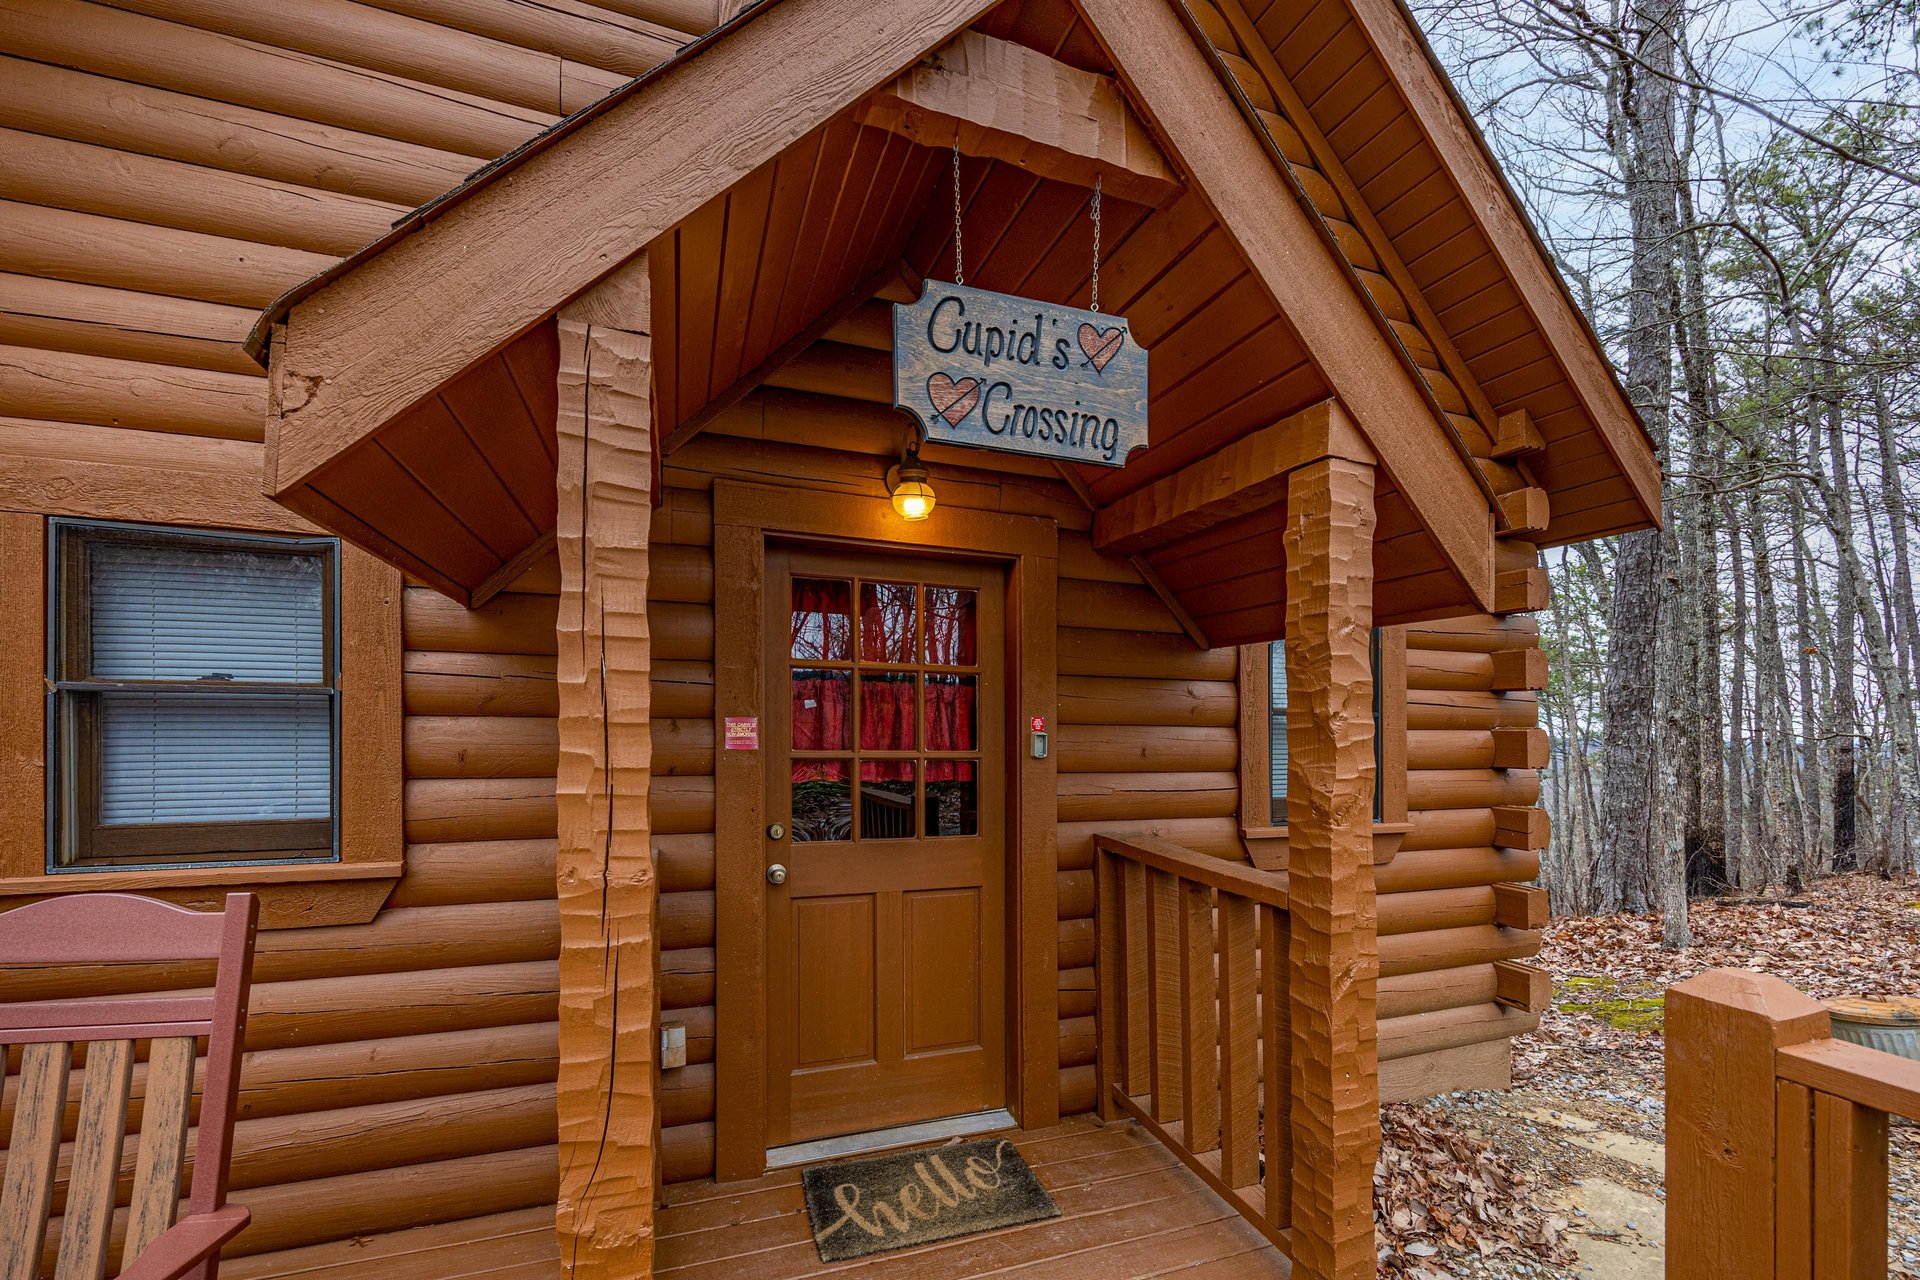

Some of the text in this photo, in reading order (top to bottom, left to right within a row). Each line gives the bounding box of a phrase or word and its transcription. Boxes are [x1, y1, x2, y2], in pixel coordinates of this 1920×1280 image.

[927, 296, 1071, 370] Cupid's
[981, 381, 1119, 461] Crossing
[817, 1139, 1008, 1238] hello
